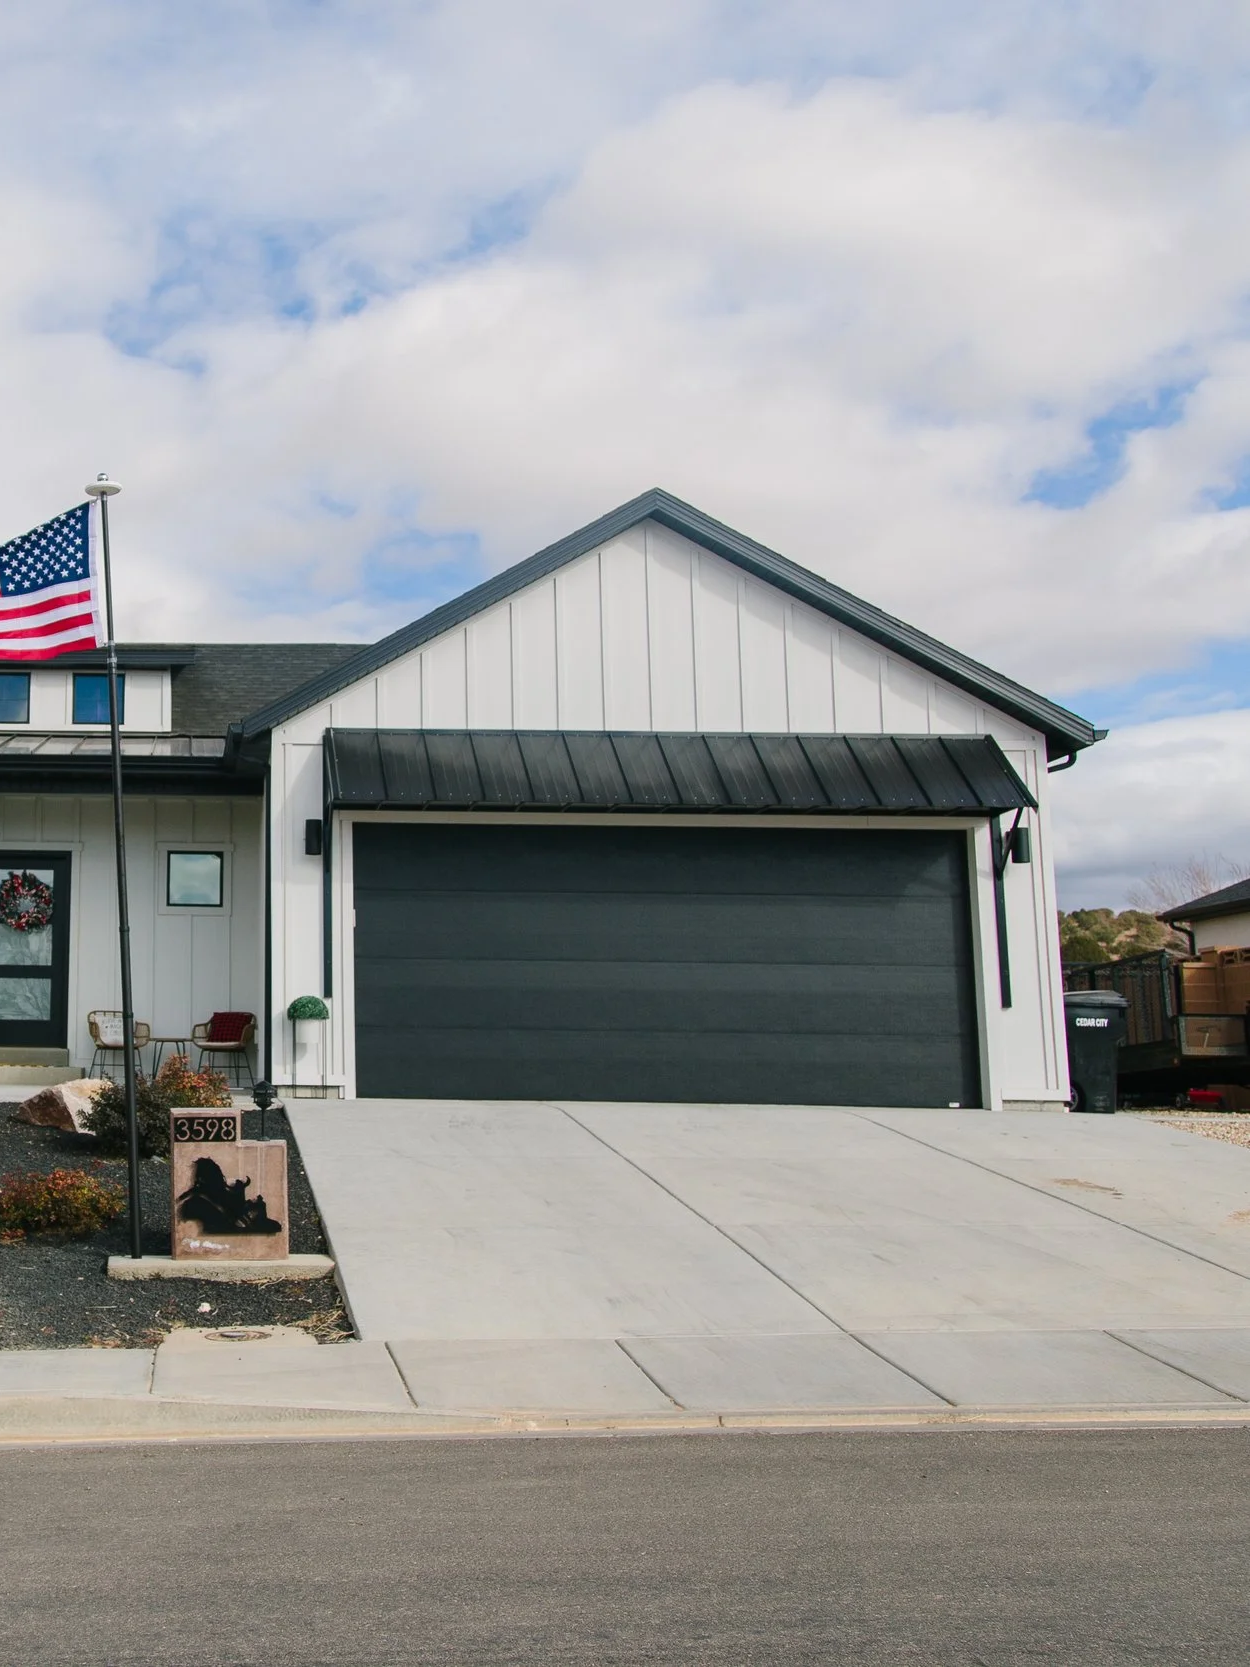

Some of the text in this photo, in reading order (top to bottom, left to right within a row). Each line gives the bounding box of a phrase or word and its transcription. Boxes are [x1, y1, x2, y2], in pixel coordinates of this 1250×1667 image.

[1075, 1017, 1109, 1027] CEDAR CITY
[176, 1119, 235, 1140] 3598
